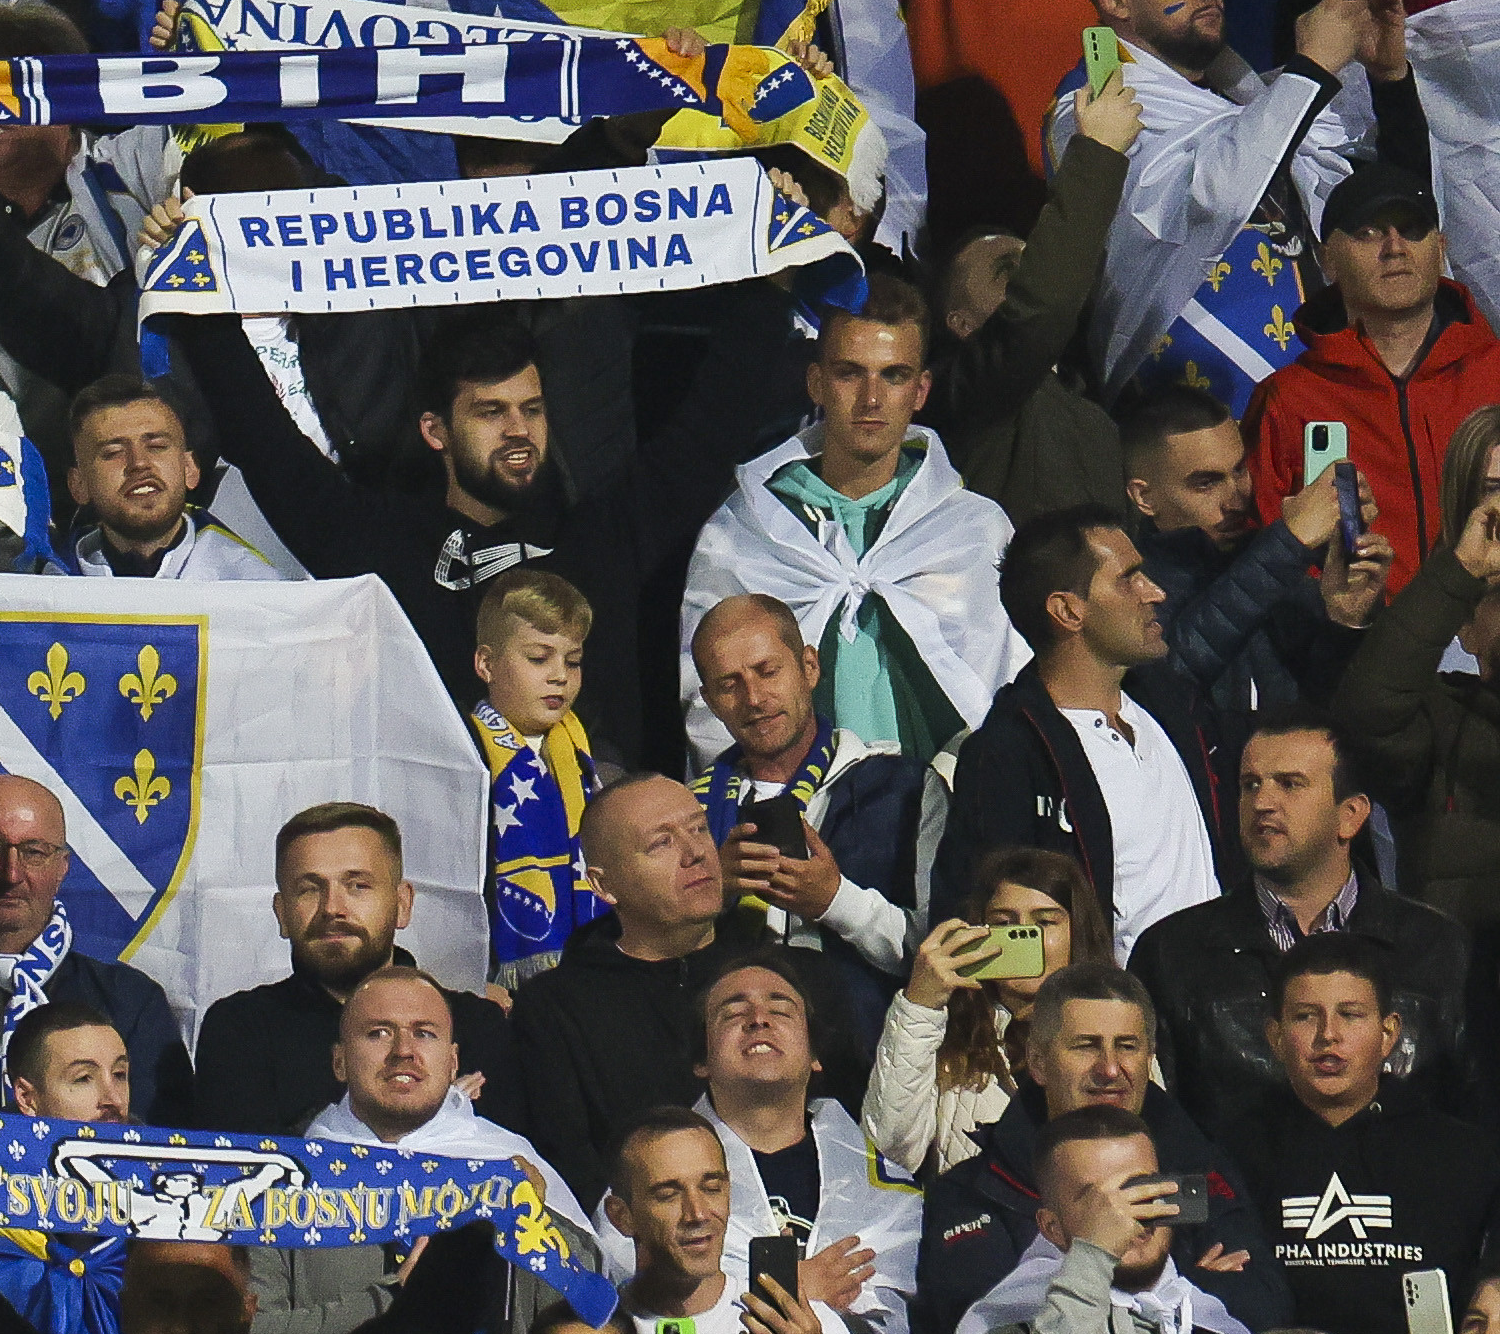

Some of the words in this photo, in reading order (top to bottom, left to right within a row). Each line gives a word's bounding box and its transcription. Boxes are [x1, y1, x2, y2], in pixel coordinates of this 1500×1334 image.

[239, 196, 540, 247] REPUBLIKA
[560, 184, 733, 229] BOSNA
[292, 261, 302, 292] I
[324, 234, 692, 291] HERCEGOVINA
[262, 1184, 395, 1231] BOSNU
[1276, 1245, 1311, 1258] PHA
[1318, 1243, 1422, 1265] INDUSTRIES
